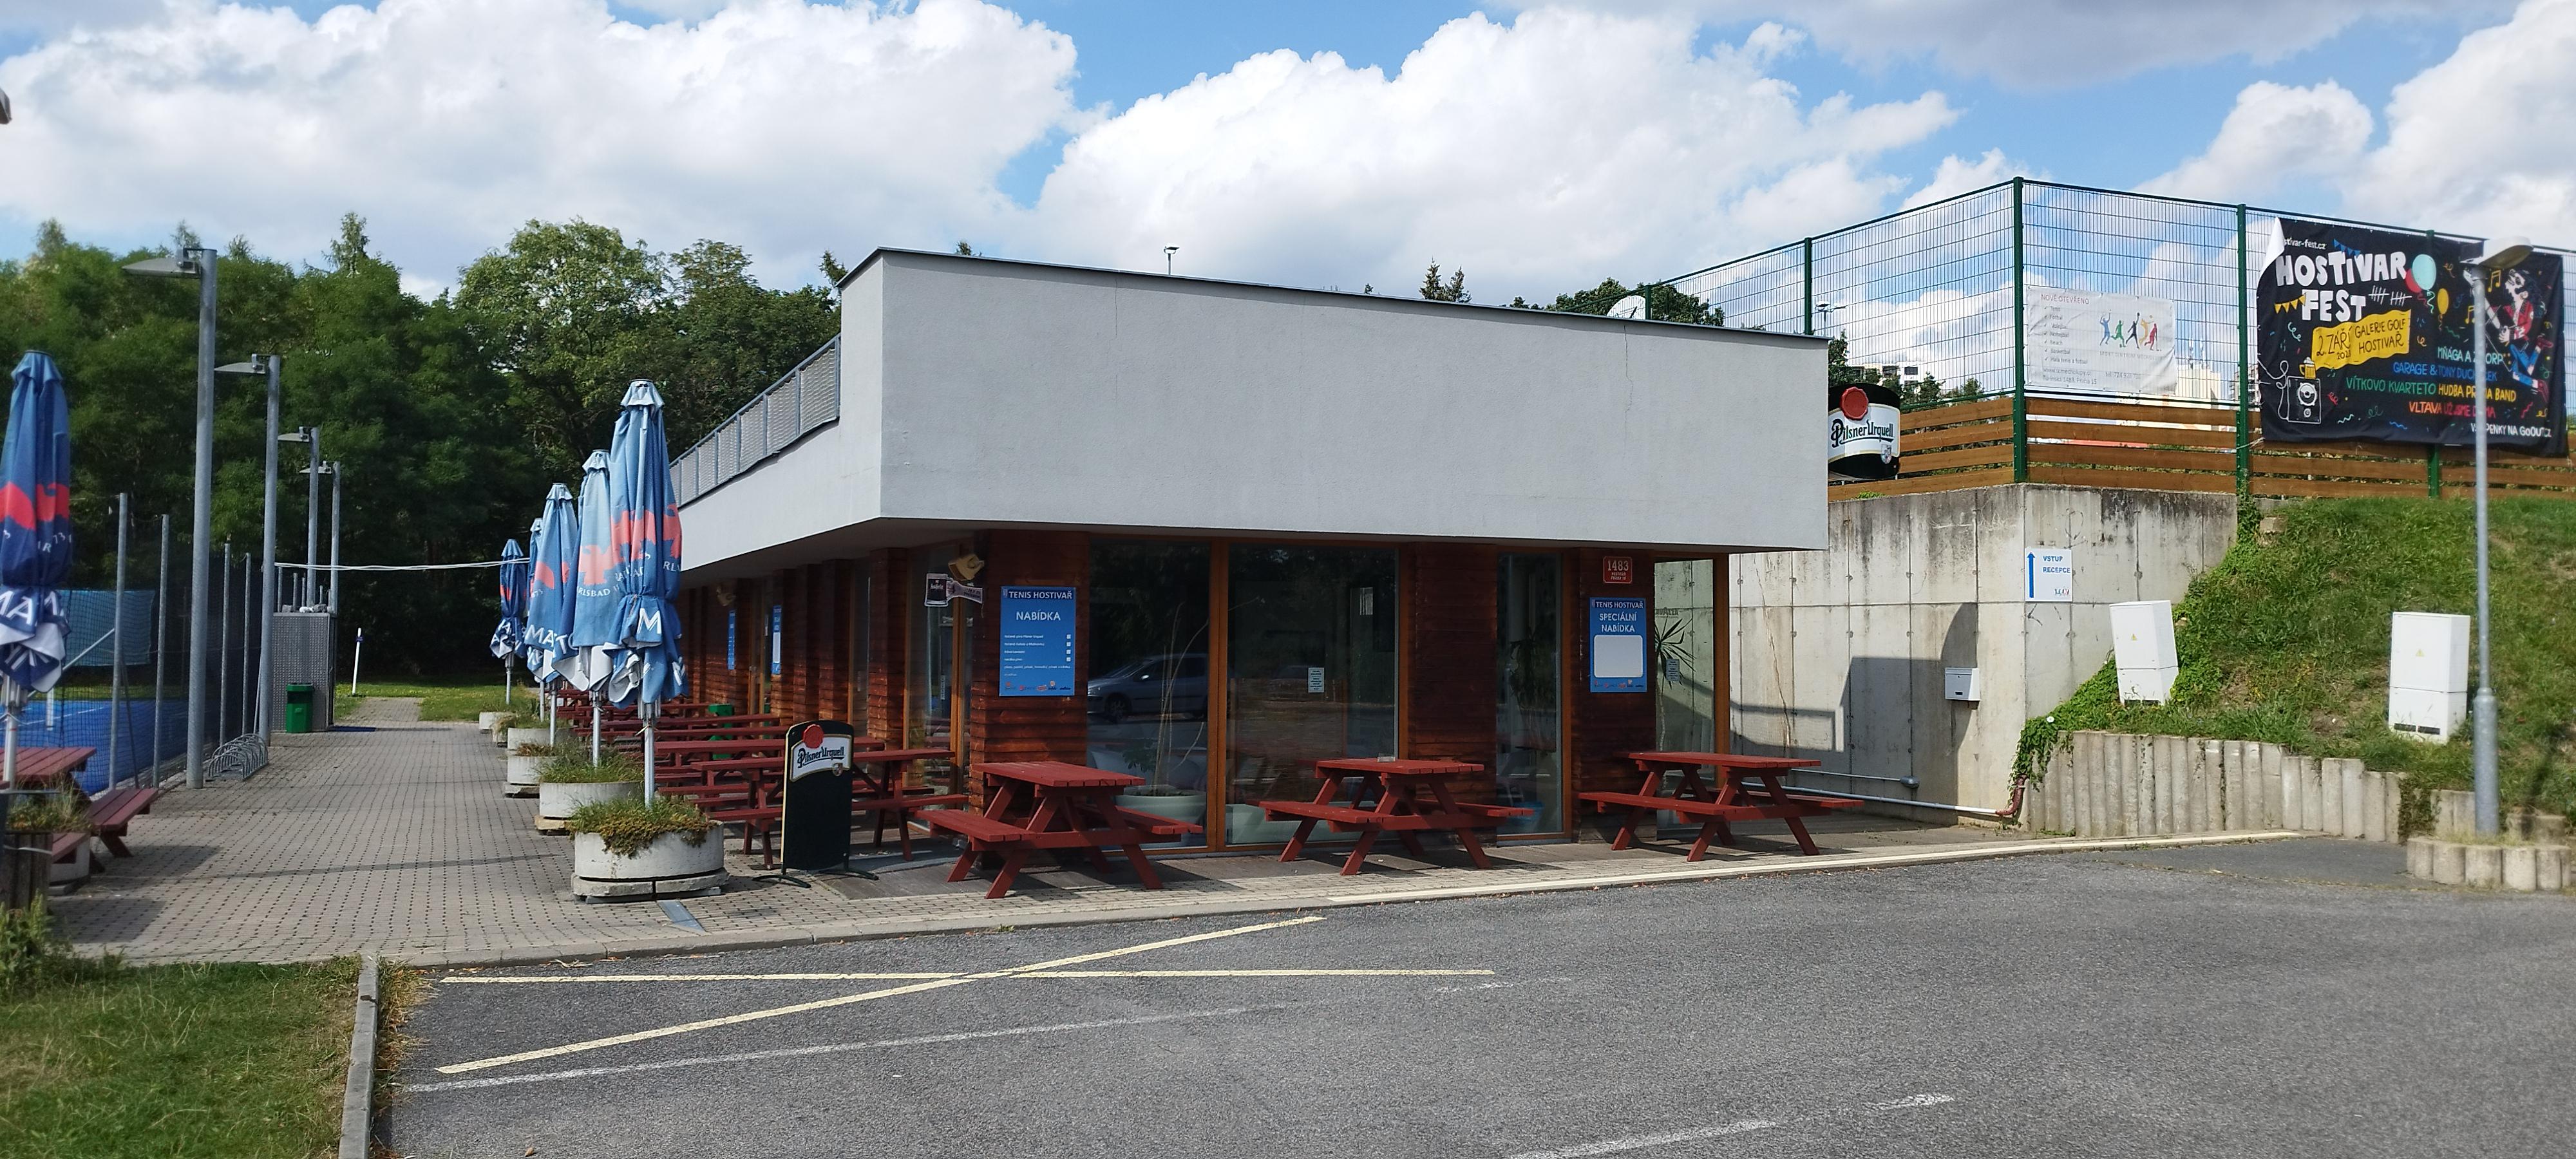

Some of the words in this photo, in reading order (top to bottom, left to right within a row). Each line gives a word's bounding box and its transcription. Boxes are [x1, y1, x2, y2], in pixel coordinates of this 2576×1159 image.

[2302, 289, 2366, 322] FEST
[2354, 322, 2385, 339] GALERIE
[2387, 318, 2406, 332] GOLF
[2358, 331, 2404, 355] HOSTIVAŘ
[2438, 346, 2463, 363] MŇÁGA
[2465, 352, 2472, 363] A
[2393, 361, 2427, 375] GARAGE
[2430, 364, 2438, 375] &
[2438, 365, 2456, 379] TONY
[2346, 375, 2385, 391] VÍTKOVO
[2389, 381, 2436, 395] KVARTETO
[2438, 383, 2465, 398] HUDBA
[2466, 386, 2493, 400] PRA
[2495, 388, 2517, 402] BAND
[2409, 401, 2442, 414] VLTAVA
[1830, 419, 1866, 448] Pilsner
[1866, 419, 1893, 443] Urquell
[2508, 425, 2517, 435] NA
[1607, 560, 1629, 571] 1483
[1033, 590, 1072, 599] HOSTIVAŘ
[1615, 600, 1643, 608] HOSTIVAŘ
[1016, 609, 1061, 621] NABÍDKA
[1599, 612, 1637, 621] SPECIÁLNÍ
[1602, 623, 1635, 633] NABÍDKA
[797, 748, 822, 769] Pilsner
[821, 746, 844, 760] Urquell
